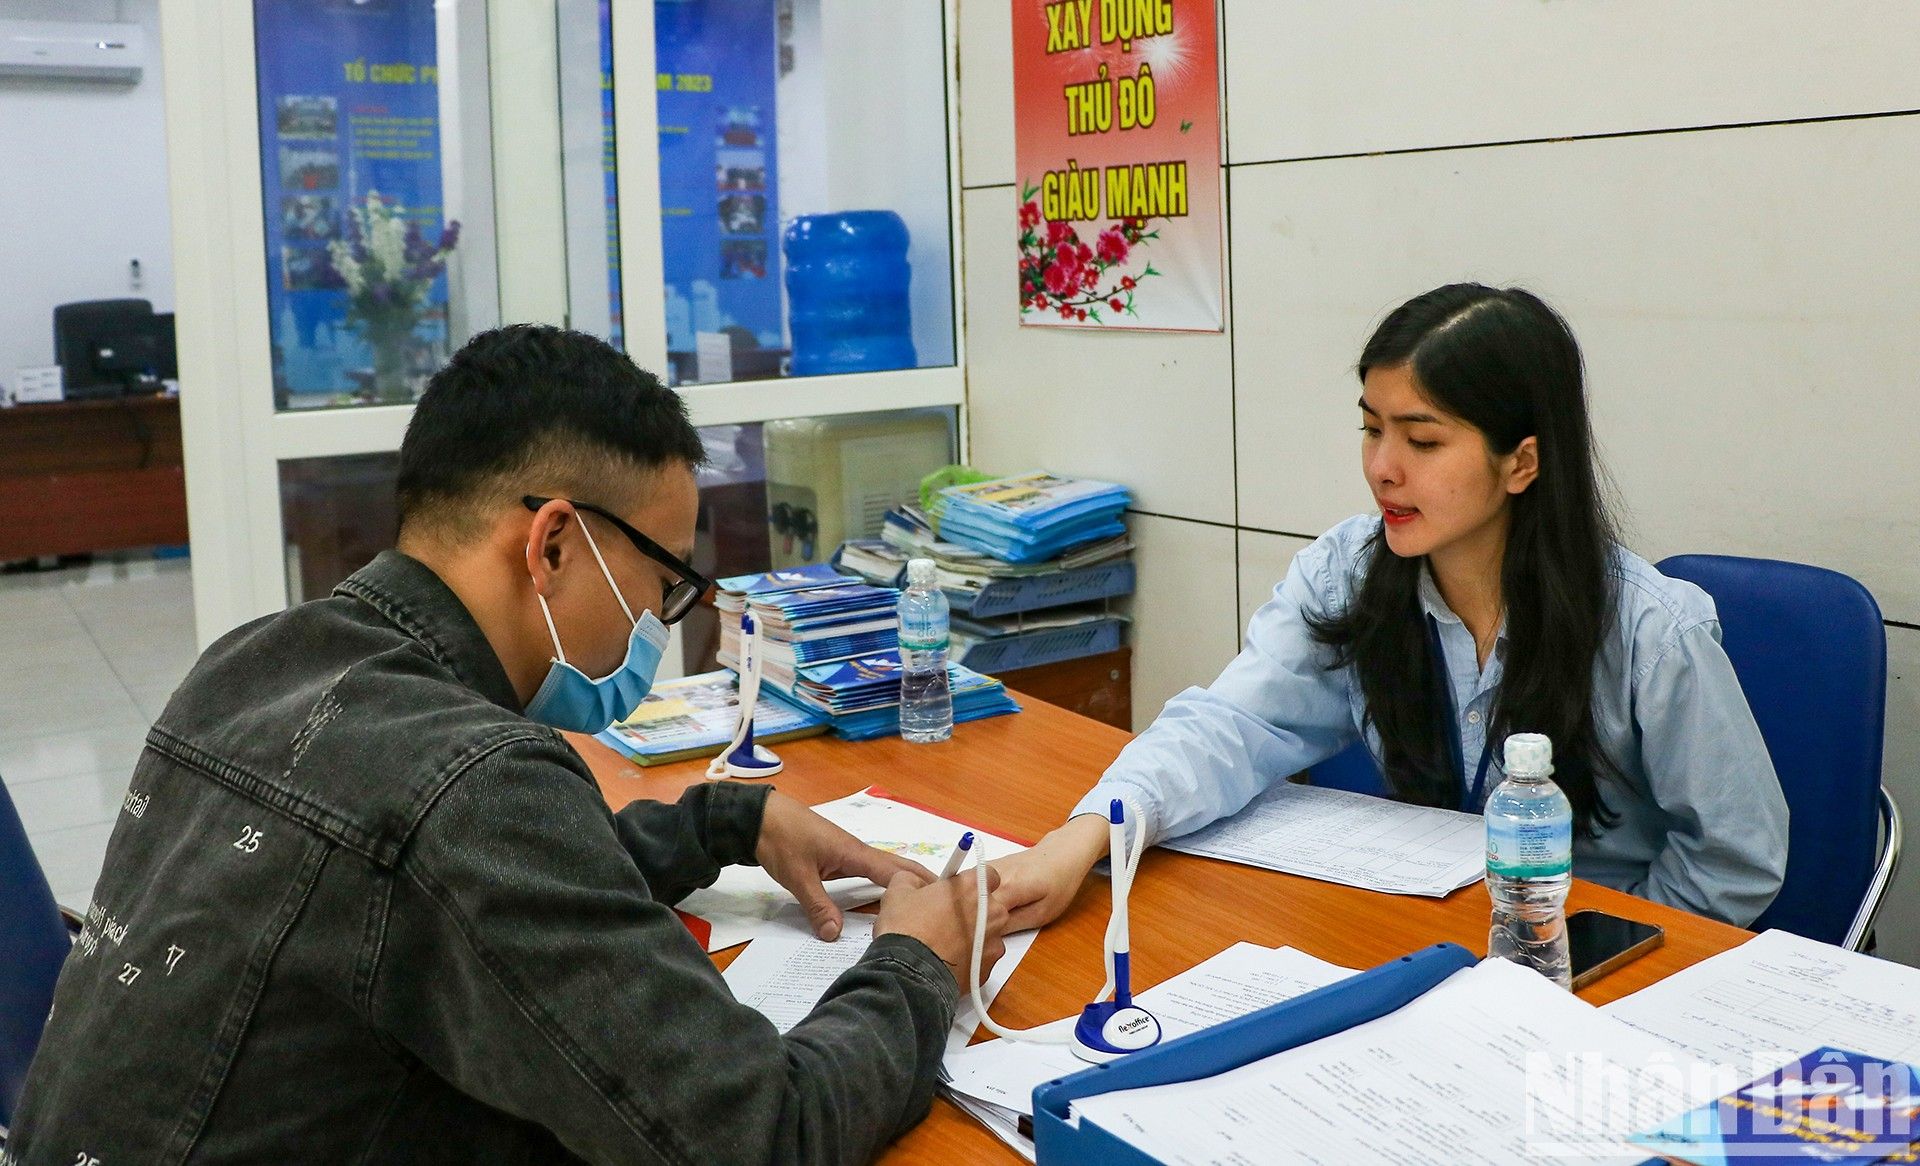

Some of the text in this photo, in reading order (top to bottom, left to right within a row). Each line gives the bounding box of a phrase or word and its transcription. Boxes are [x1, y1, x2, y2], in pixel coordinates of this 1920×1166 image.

[1065, 62, 1156, 136] THỦ ĐÔ
[1042, 159, 1188, 229] GIÀU MẠNH
[233, 825, 263, 853] 25
[118, 962, 142, 986] 27
[165, 944, 186, 976] 17
